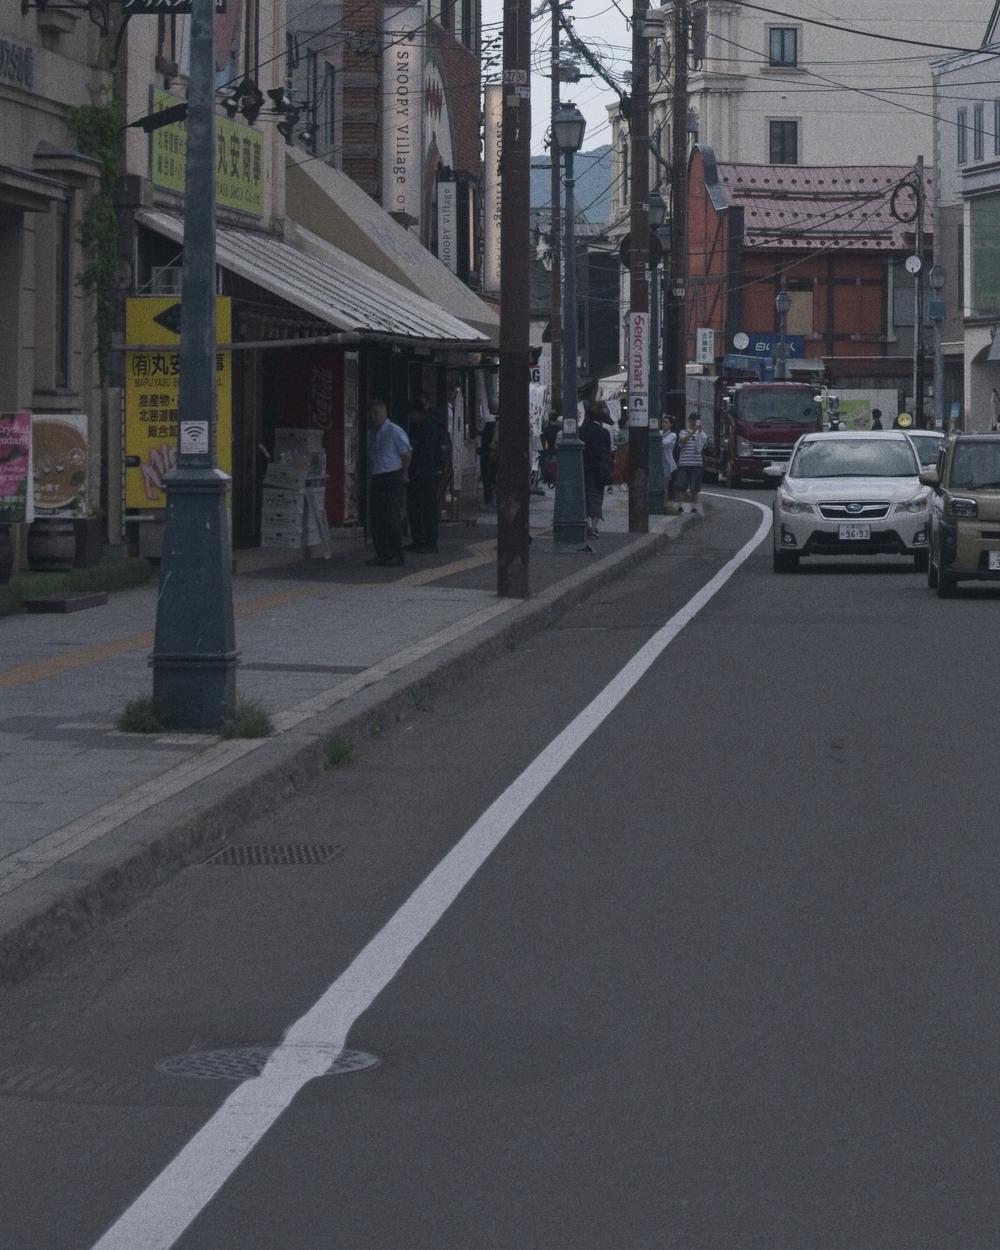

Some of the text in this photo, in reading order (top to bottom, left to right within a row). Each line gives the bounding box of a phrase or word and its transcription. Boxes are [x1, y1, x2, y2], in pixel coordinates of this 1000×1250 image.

[396, 51, 409, 117] SNOOPY
[217, 127, 261, 186] 丸安商事
[393, 124, 410, 184] Village
